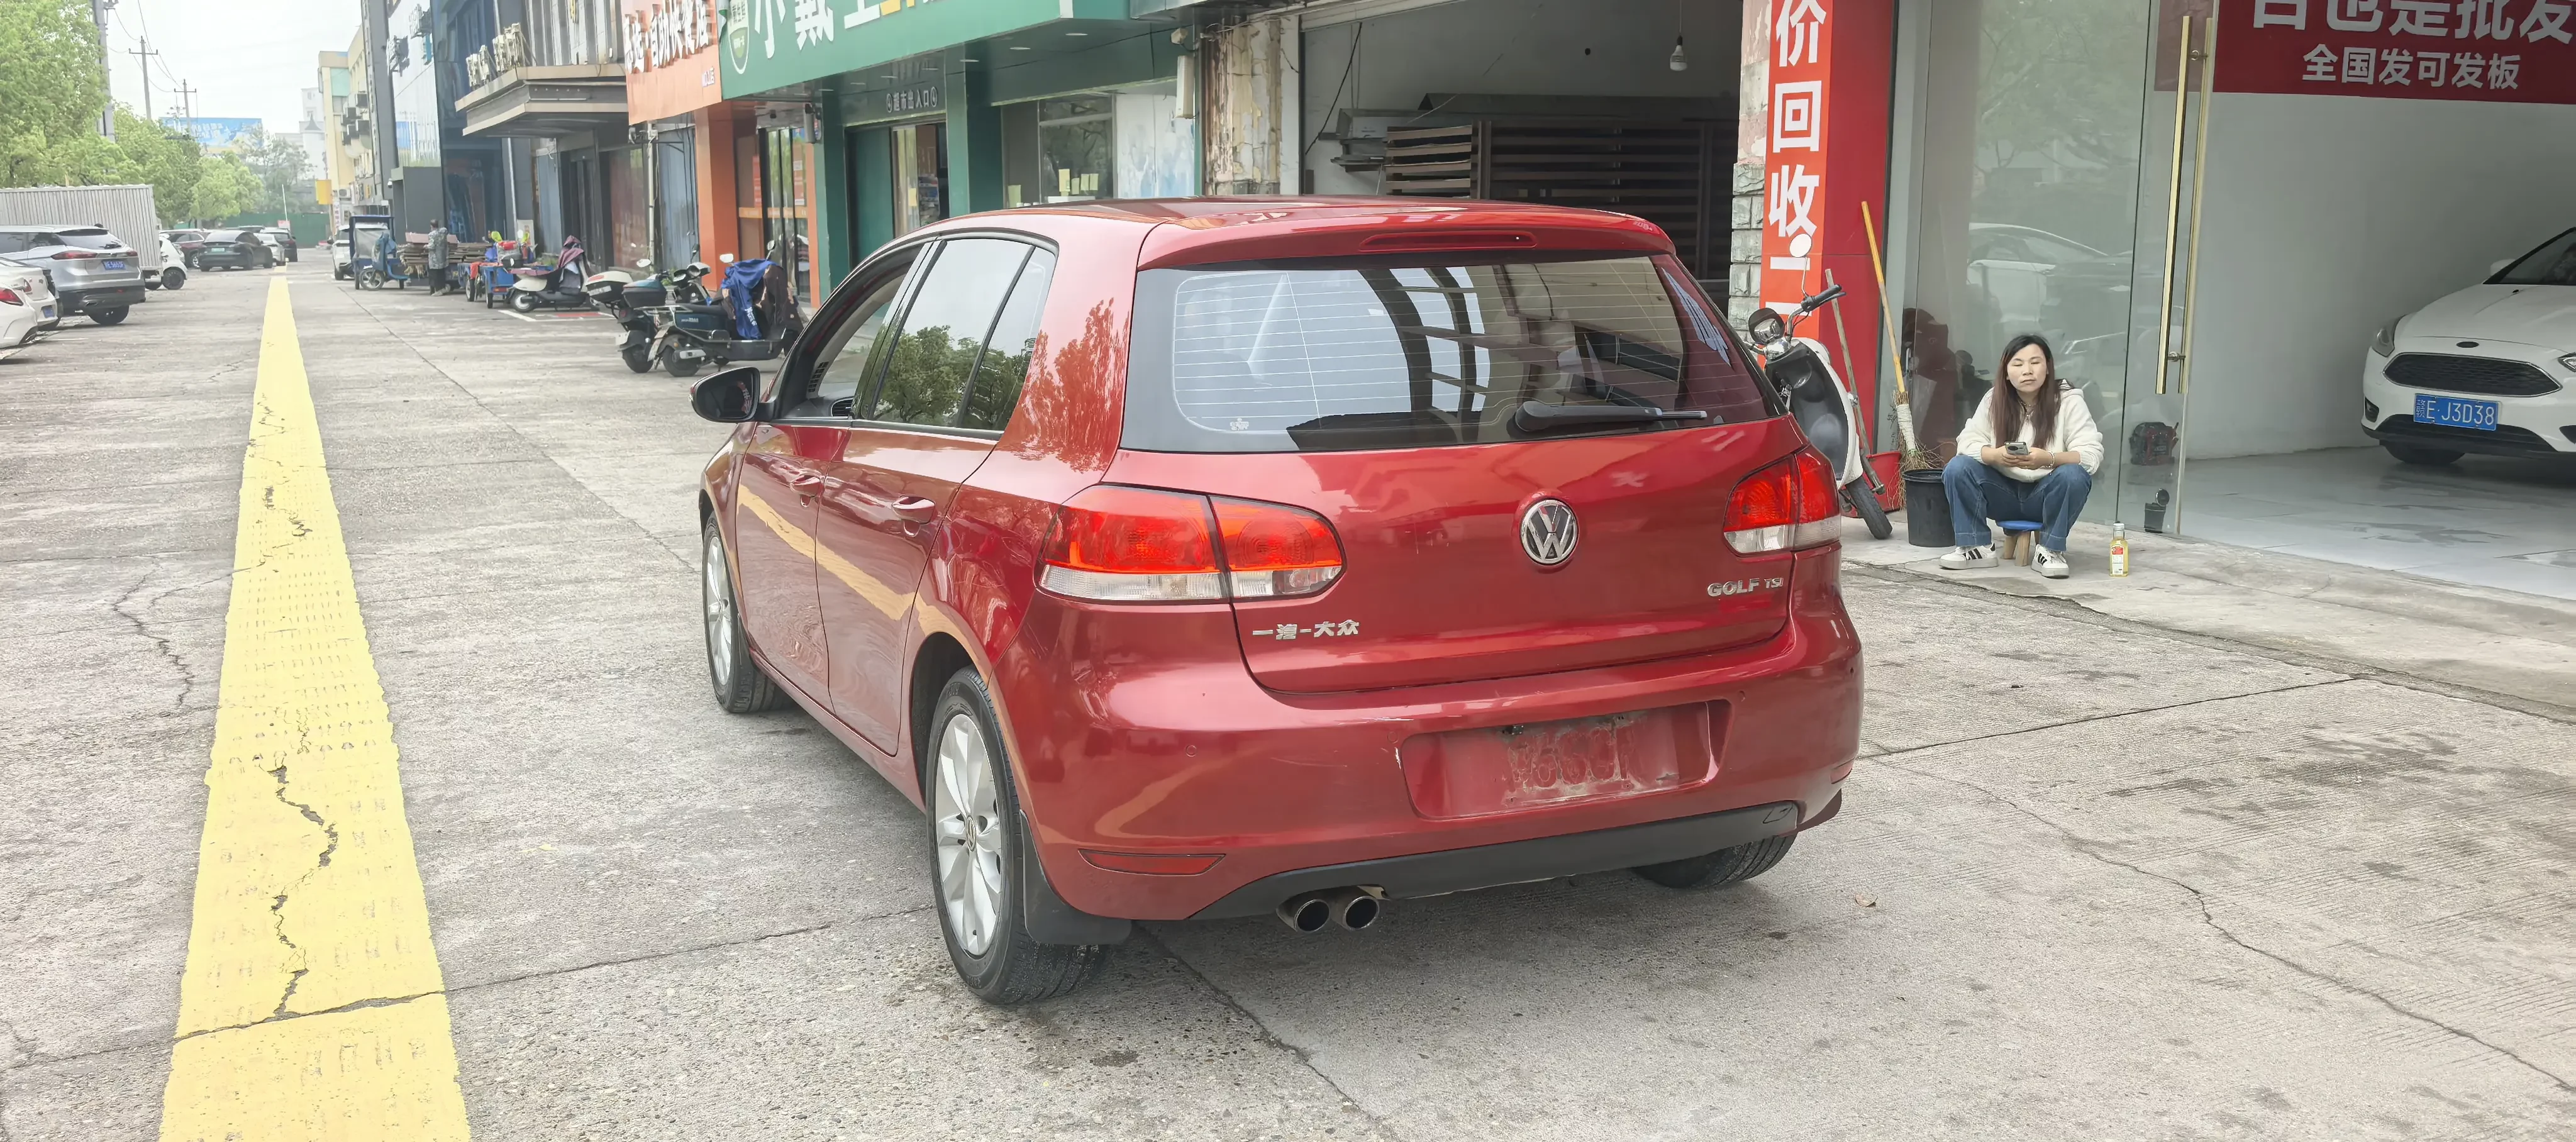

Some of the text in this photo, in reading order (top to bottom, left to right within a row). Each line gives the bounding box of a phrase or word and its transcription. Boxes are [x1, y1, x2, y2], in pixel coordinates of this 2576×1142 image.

[2302, 43, 2521, 90] 全国发可发板
[893, 89, 930, 111] 超市出入口
[1707, 577, 1784, 597] GOLF TSI
[1252, 619, 1359, 640] 一汽-大众
